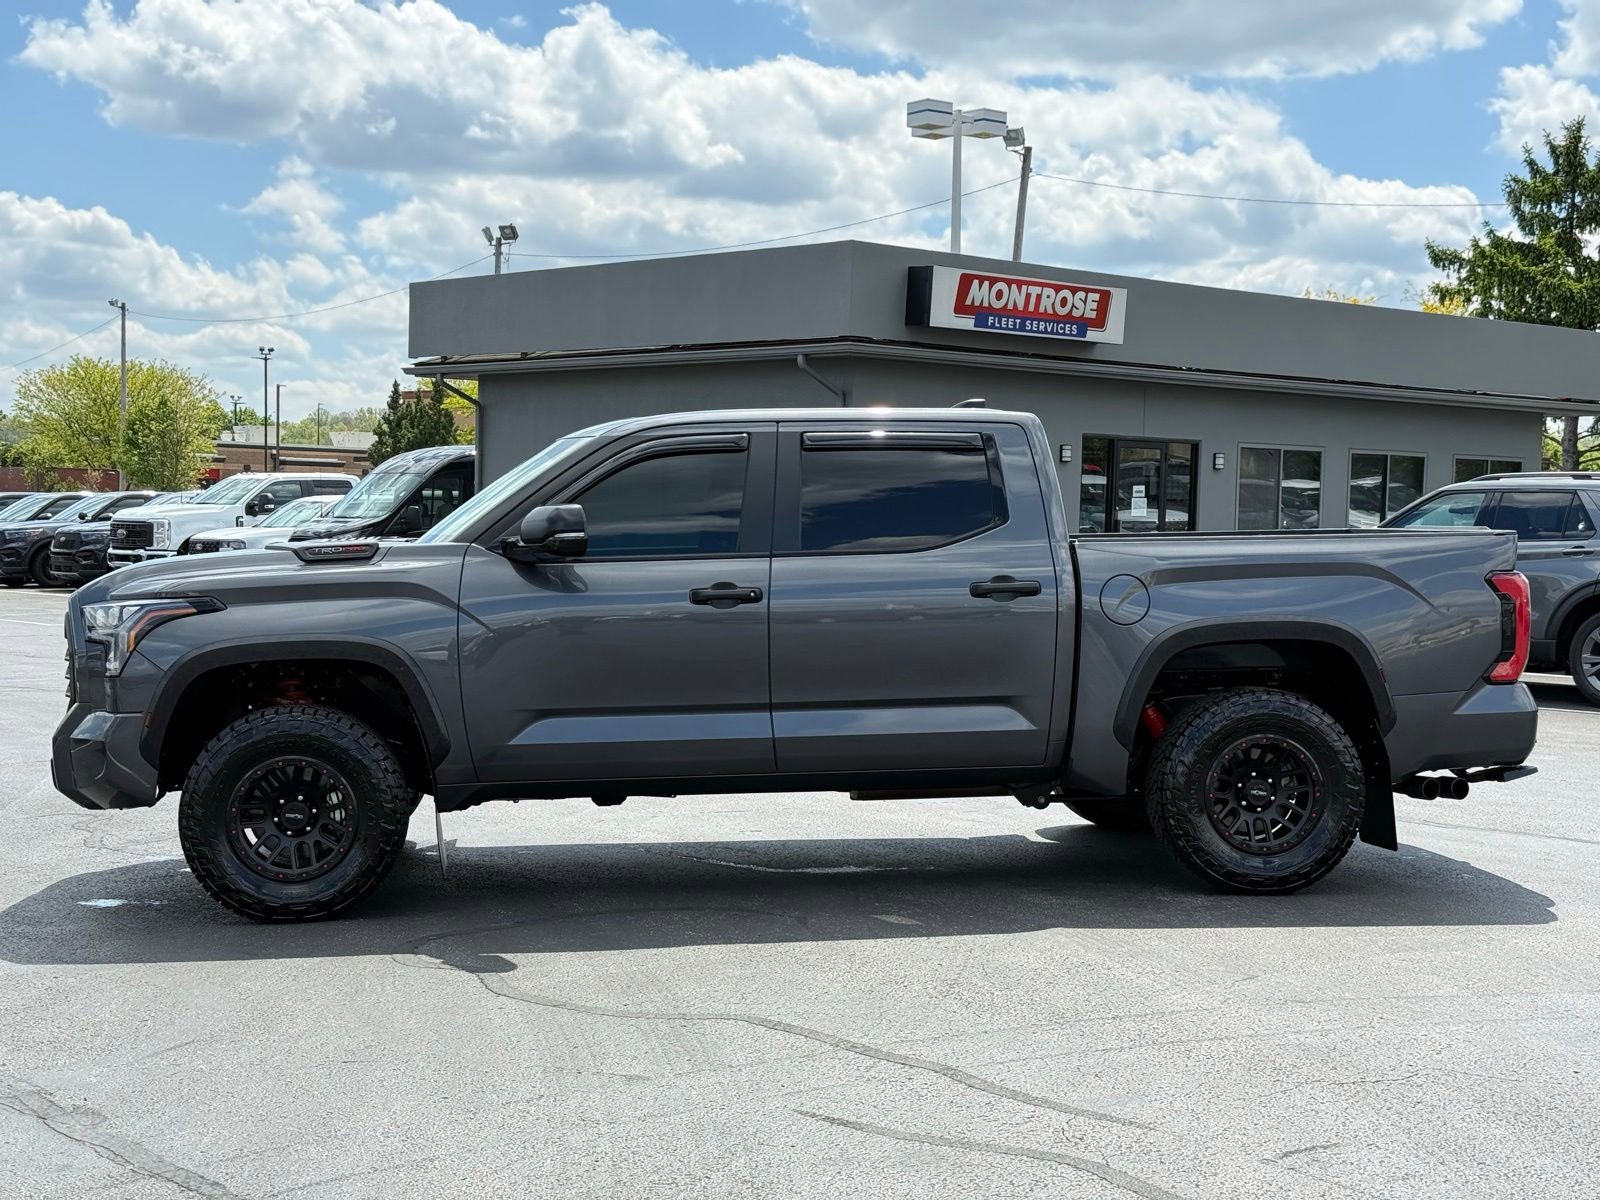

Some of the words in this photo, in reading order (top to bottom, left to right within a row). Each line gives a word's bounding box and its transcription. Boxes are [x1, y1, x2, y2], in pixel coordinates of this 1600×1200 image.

[965, 279, 1100, 318] MONTROSE
[988, 316, 1021, 329] FLEET
[1025, 320, 1078, 334] SERVICES
